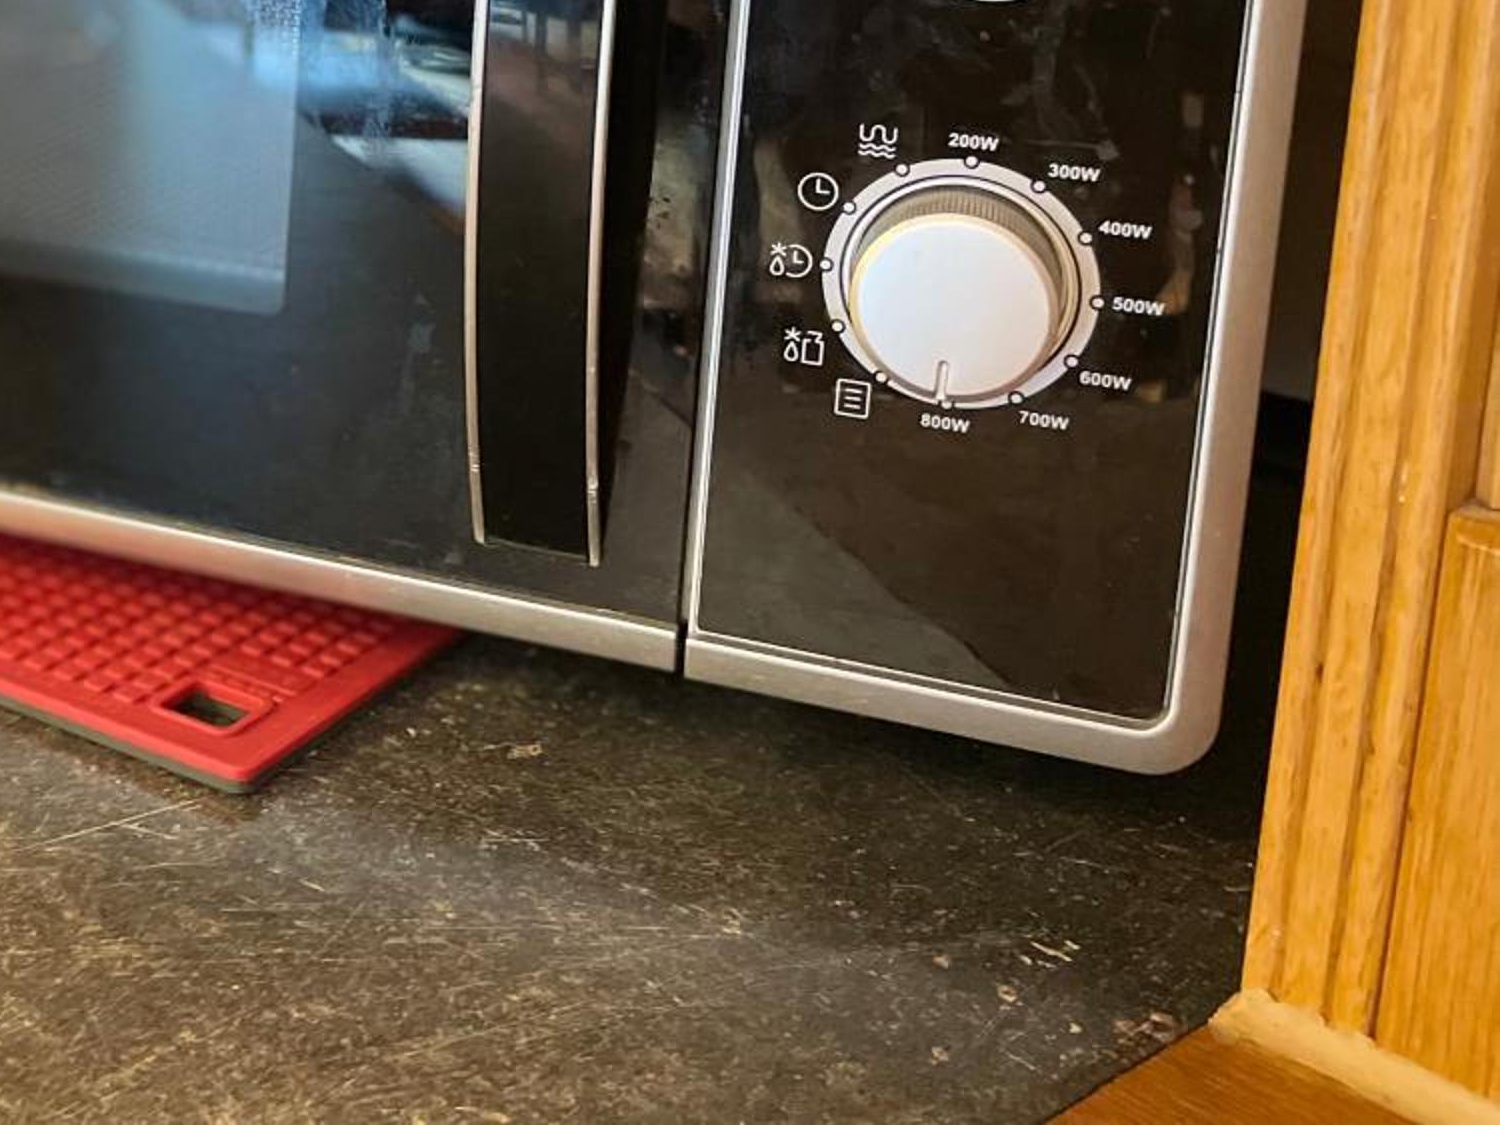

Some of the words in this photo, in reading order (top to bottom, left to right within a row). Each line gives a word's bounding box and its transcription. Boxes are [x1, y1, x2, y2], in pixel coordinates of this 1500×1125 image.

[948, 132, 1000, 152] 200W
[1047, 162, 1101, 182] 300W
[1098, 219, 1153, 240] 400W
[1112, 296, 1167, 316] 500W
[1079, 370, 1132, 391] 600W
[920, 412, 971, 434] 800W
[1018, 410, 1070, 431] 700W
